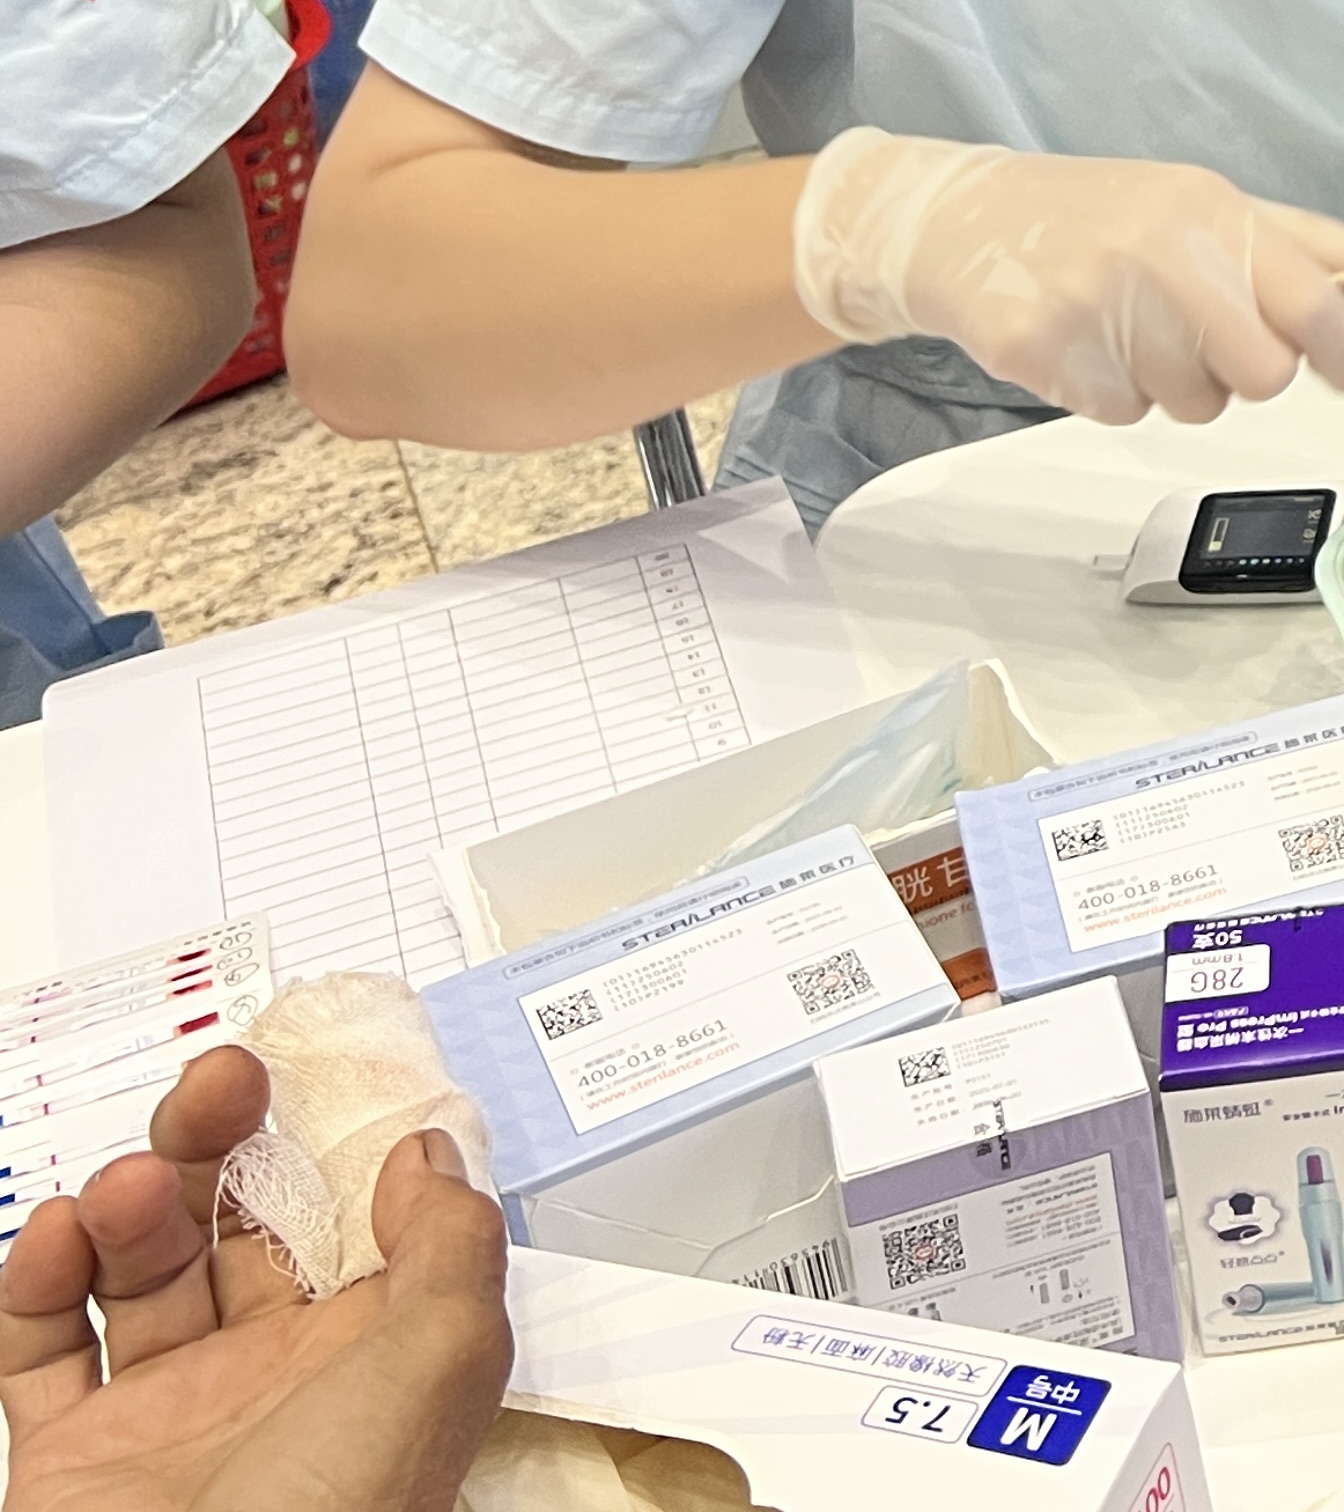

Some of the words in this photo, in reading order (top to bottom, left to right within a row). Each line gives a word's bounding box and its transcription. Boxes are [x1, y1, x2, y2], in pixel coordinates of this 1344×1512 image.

[1077, 863, 1220, 911] 400-018-8661
[1190, 966, 1245, 994] 28G
[577, 1019, 729, 1088] 400-018-8661
[1025, 1373, 1084, 1407] 中号
[884, 1395, 952, 1434] 7.5
[999, 1406, 1059, 1453] M
